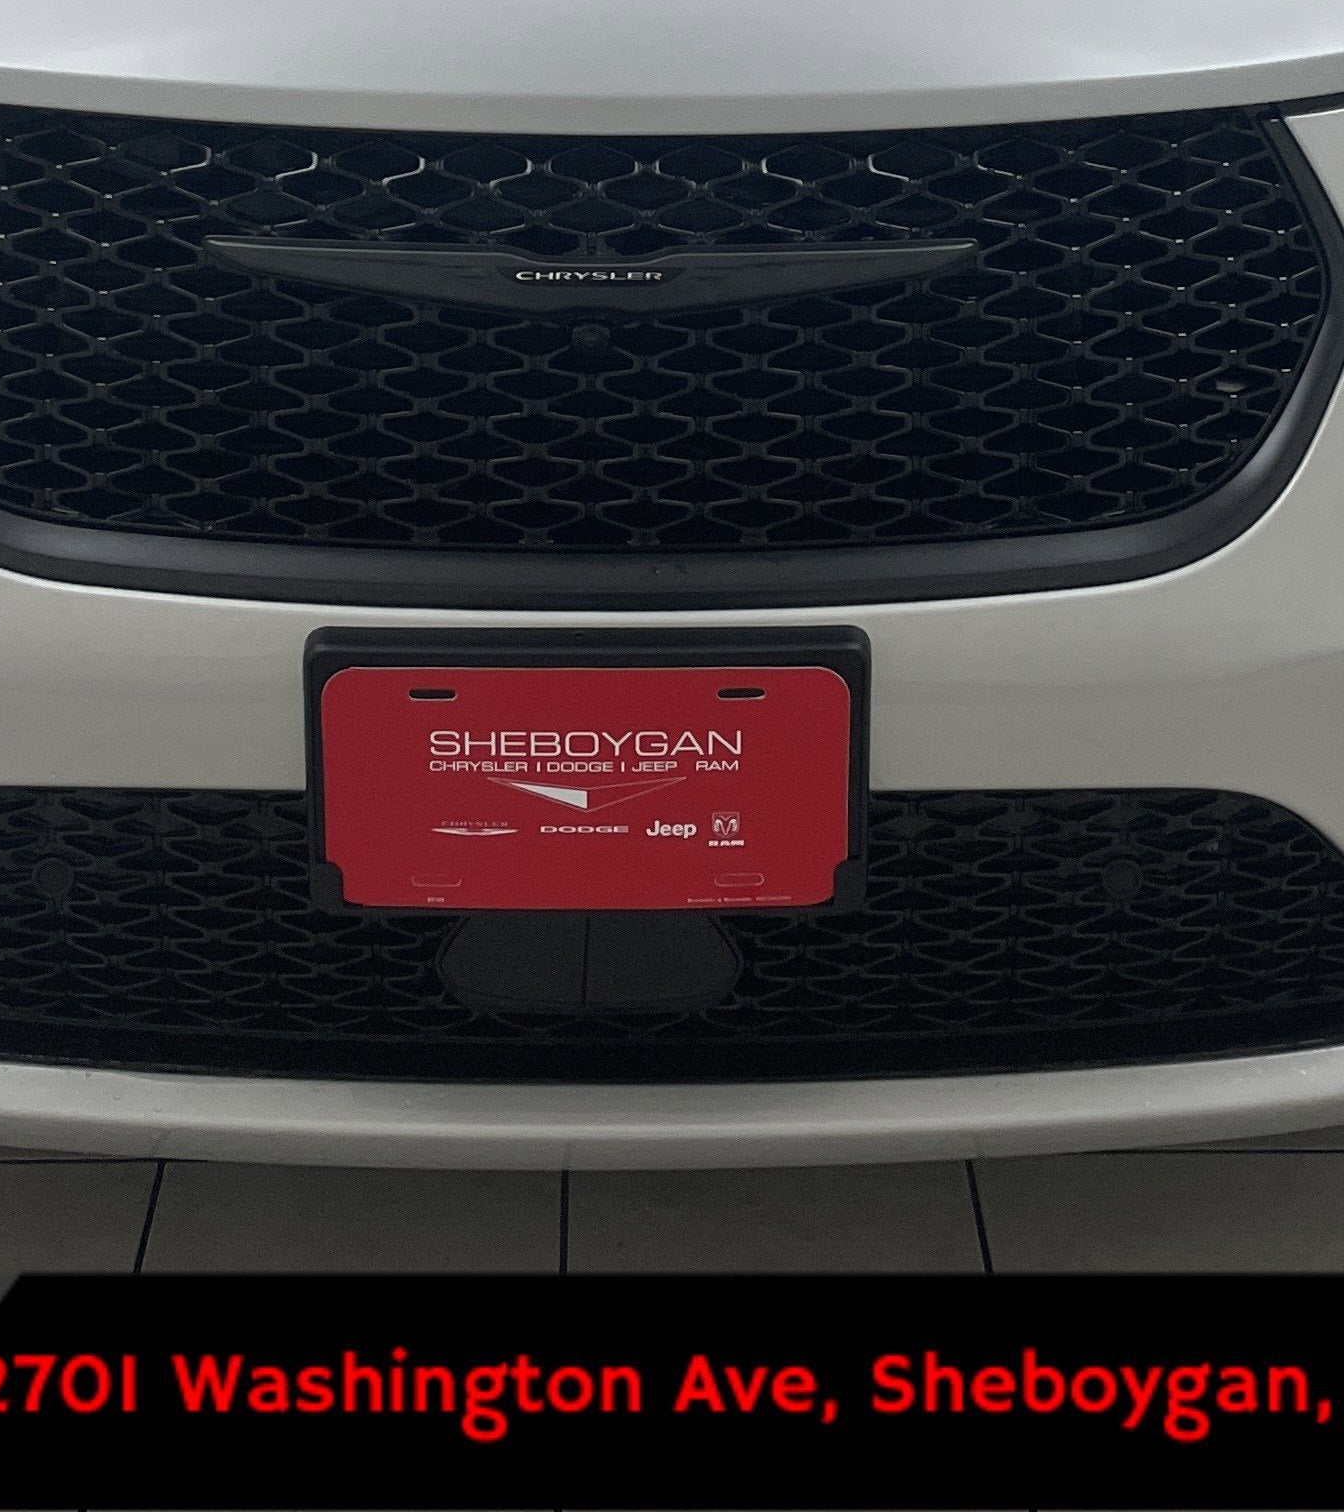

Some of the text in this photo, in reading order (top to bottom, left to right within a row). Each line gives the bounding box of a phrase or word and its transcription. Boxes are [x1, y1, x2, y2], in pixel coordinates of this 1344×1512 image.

[516, 271, 662, 281] CHRYSLER
[430, 730, 742, 757] SHEBOYGAN
[429, 760, 739, 773] CHRYSLER DODGE JEEP RAM
[540, 825, 629, 834] DODGE
[646, 820, 697, 838] Jeep
